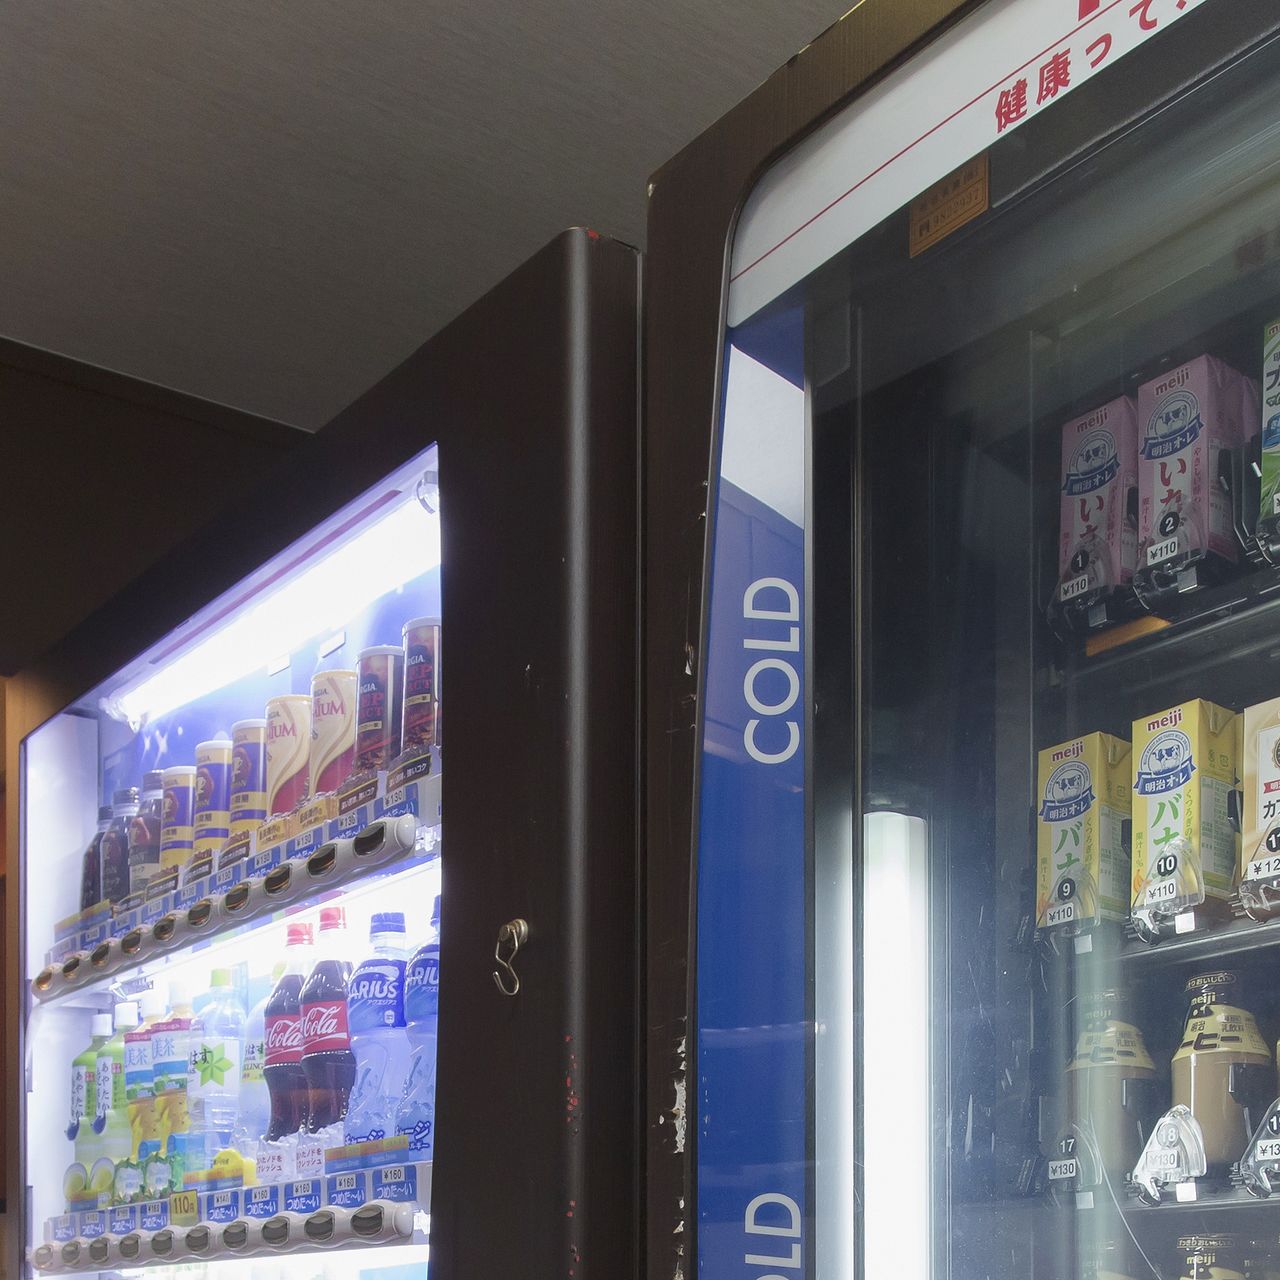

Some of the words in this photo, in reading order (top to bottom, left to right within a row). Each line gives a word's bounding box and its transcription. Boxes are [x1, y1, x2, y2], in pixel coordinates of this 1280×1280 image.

[1155, 367, 1191, 396] meiji
[1076, 407, 1108, 433] meiji
[1151, 429, 1195, 458] 明治オ・レ
[1150, 540, 1177, 560] ¥110
[1062, 579, 1087, 598] ¥110
[743, 577, 800, 764] COLD
[1147, 709, 1183, 732] meiji
[1052, 741, 1084, 762] meiji
[1145, 770, 1188, 792] 明治オ・レ
[1049, 802, 1088, 820] 明治オ・レ
[1158, 855, 1176, 873] 10
[1149, 883, 1175, 899] ¥110
[1049, 908, 1073, 922] ¥110
